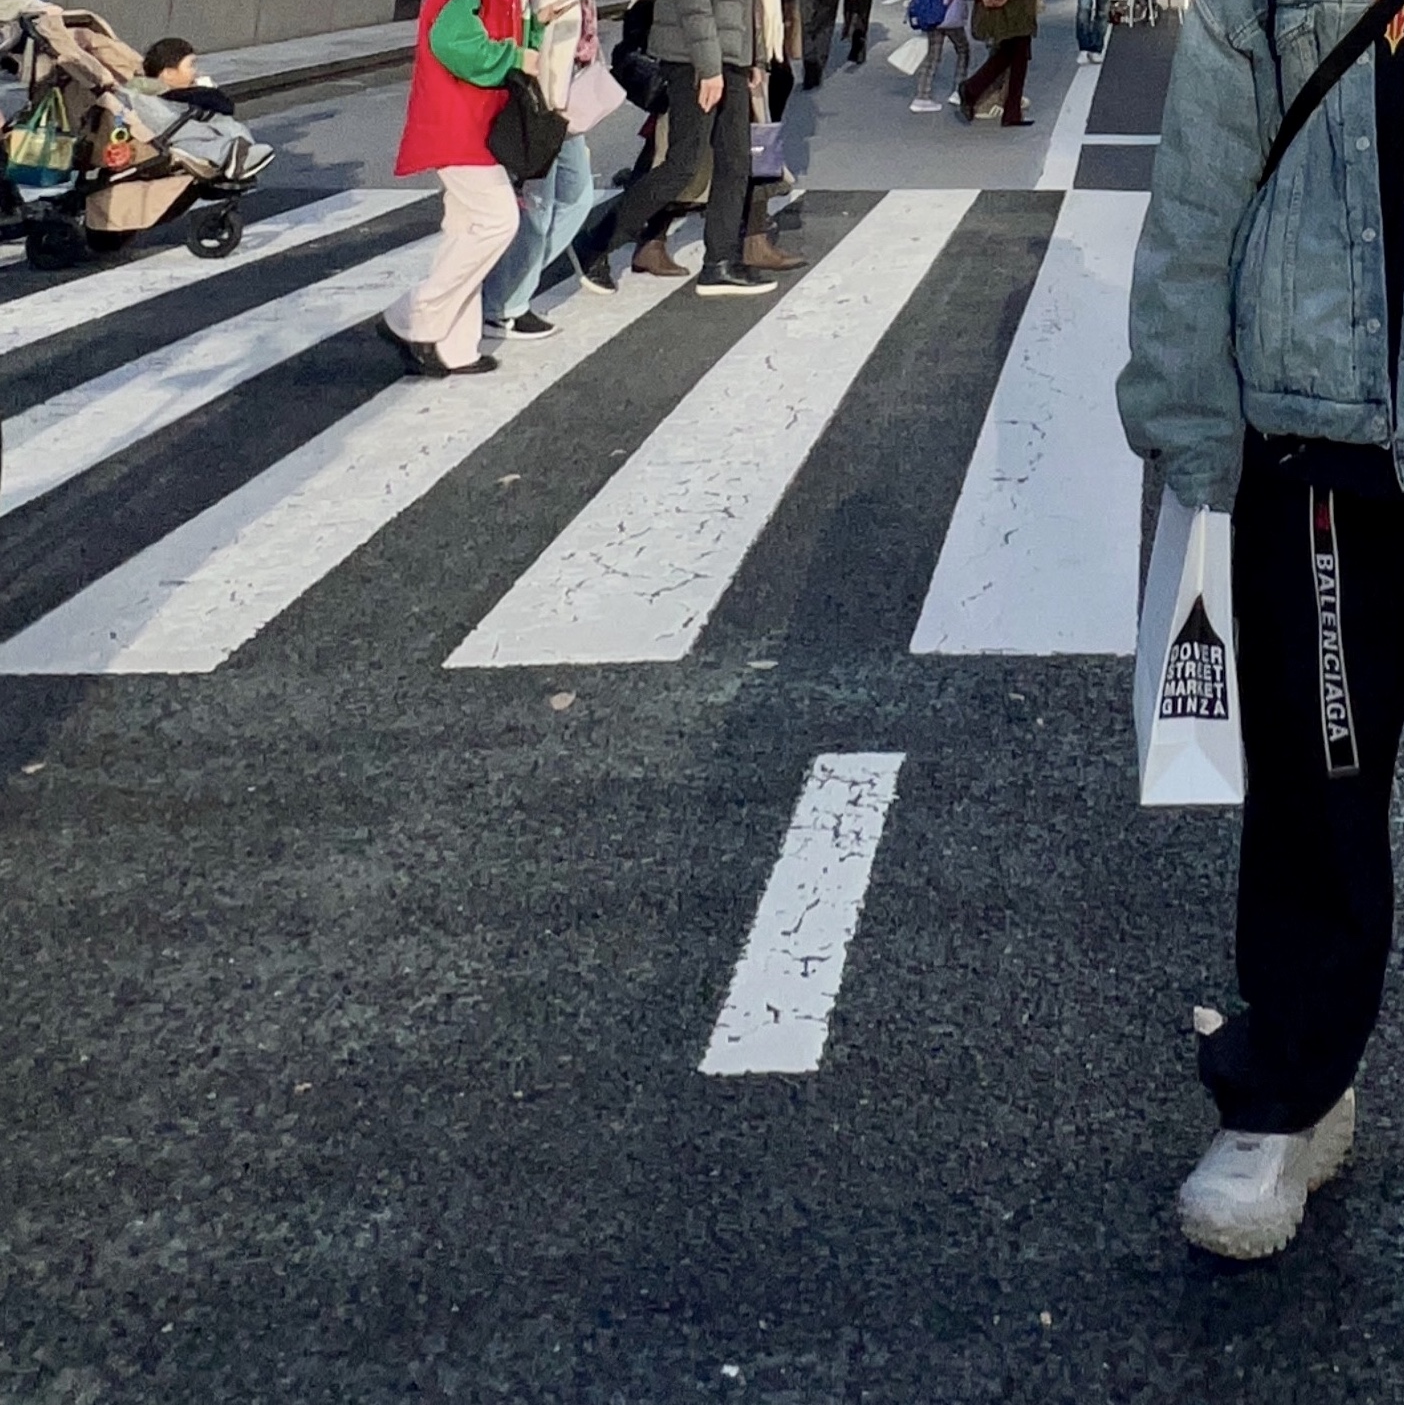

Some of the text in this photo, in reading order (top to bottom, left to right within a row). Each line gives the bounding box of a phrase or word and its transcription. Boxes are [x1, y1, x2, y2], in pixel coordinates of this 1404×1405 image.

[1316, 553, 1349, 742] BALENCIAGA
[1166, 661, 1223, 682] STREET
[1163, 679, 1224, 699] MARKET
[1162, 697, 1226, 715] GINZA
